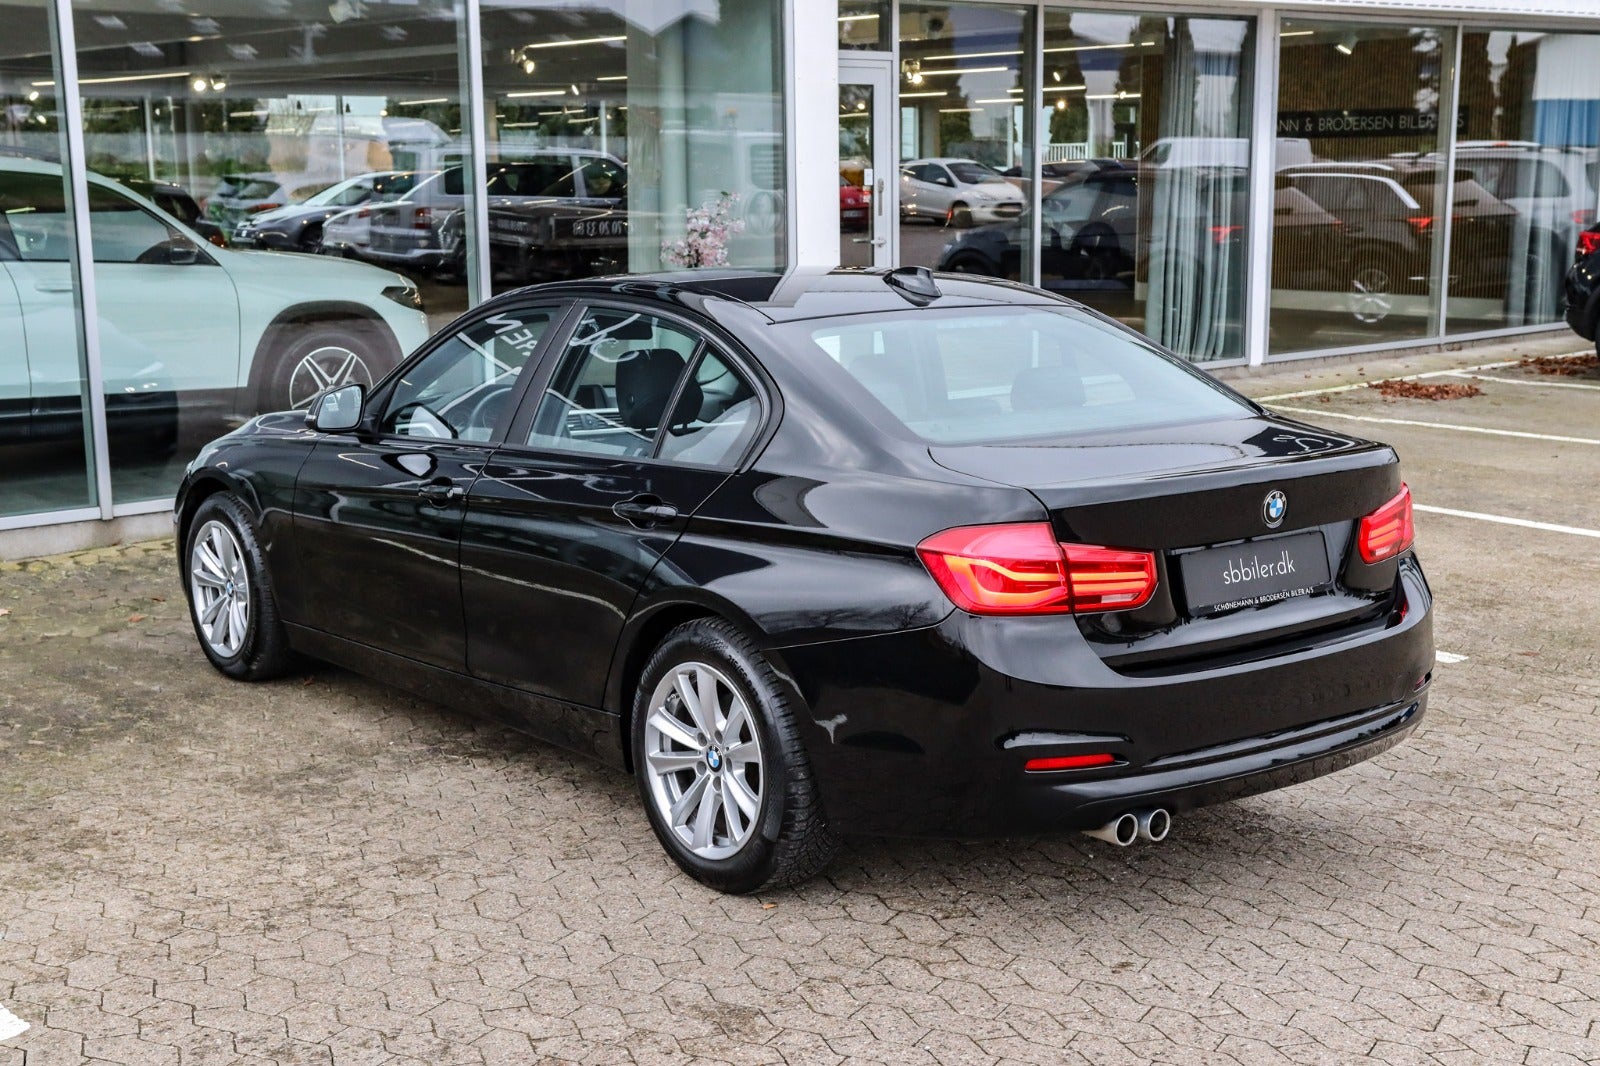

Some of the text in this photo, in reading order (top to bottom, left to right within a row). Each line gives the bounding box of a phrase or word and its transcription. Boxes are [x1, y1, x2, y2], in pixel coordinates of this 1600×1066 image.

[1318, 115, 1393, 131] BRODERSEN
[1223, 550, 1295, 585] sbbiler.dk
[1260, 591, 1290, 603] BRODERSEN
[1291, 588, 1305, 597] BILER
